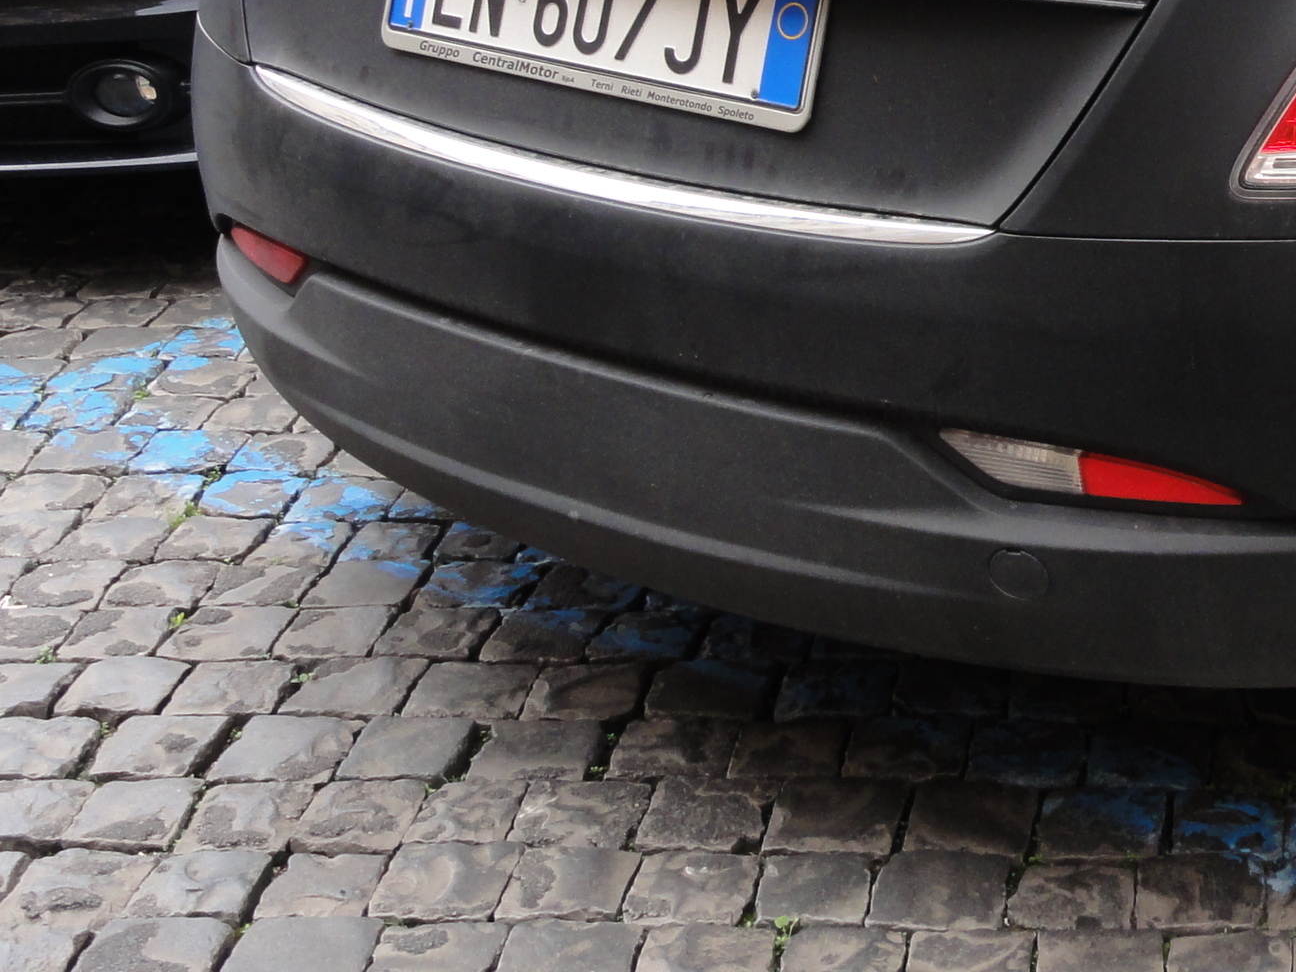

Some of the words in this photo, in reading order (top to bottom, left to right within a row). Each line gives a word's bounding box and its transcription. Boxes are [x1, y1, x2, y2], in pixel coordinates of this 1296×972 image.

[419, 40, 461, 59] Gruppo
[472, 51, 560, 81] CentralMotor
[591, 78, 615, 92] Terni
[620, 84, 643, 98] Rieti
[646, 90, 713, 113] Monterotondo
[717, 105, 756, 121] Spoleto
